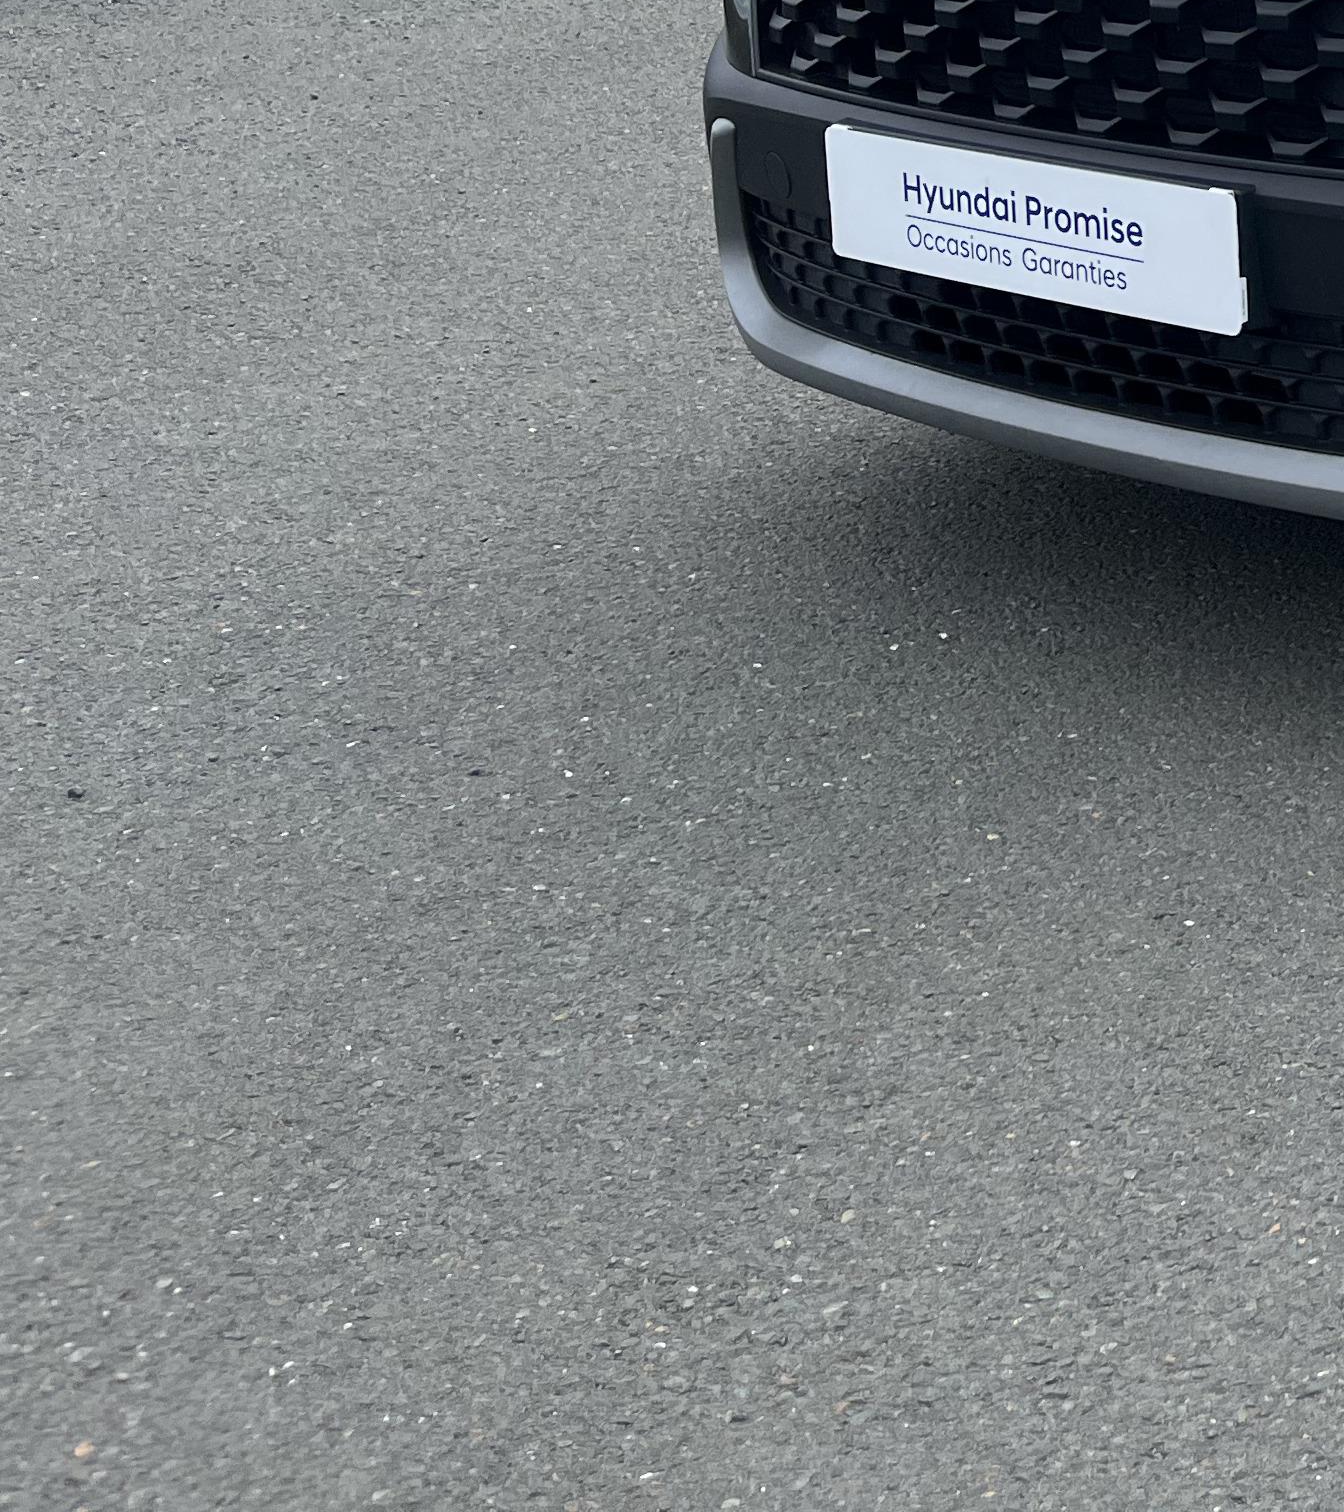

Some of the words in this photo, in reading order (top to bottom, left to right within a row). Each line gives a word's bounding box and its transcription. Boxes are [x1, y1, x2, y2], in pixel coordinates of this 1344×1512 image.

[903, 172, 1018, 224] Hyundai
[1025, 196, 1144, 247] Promise
[907, 224, 1012, 267] Occasions
[1022, 248, 1127, 290] Garanties
